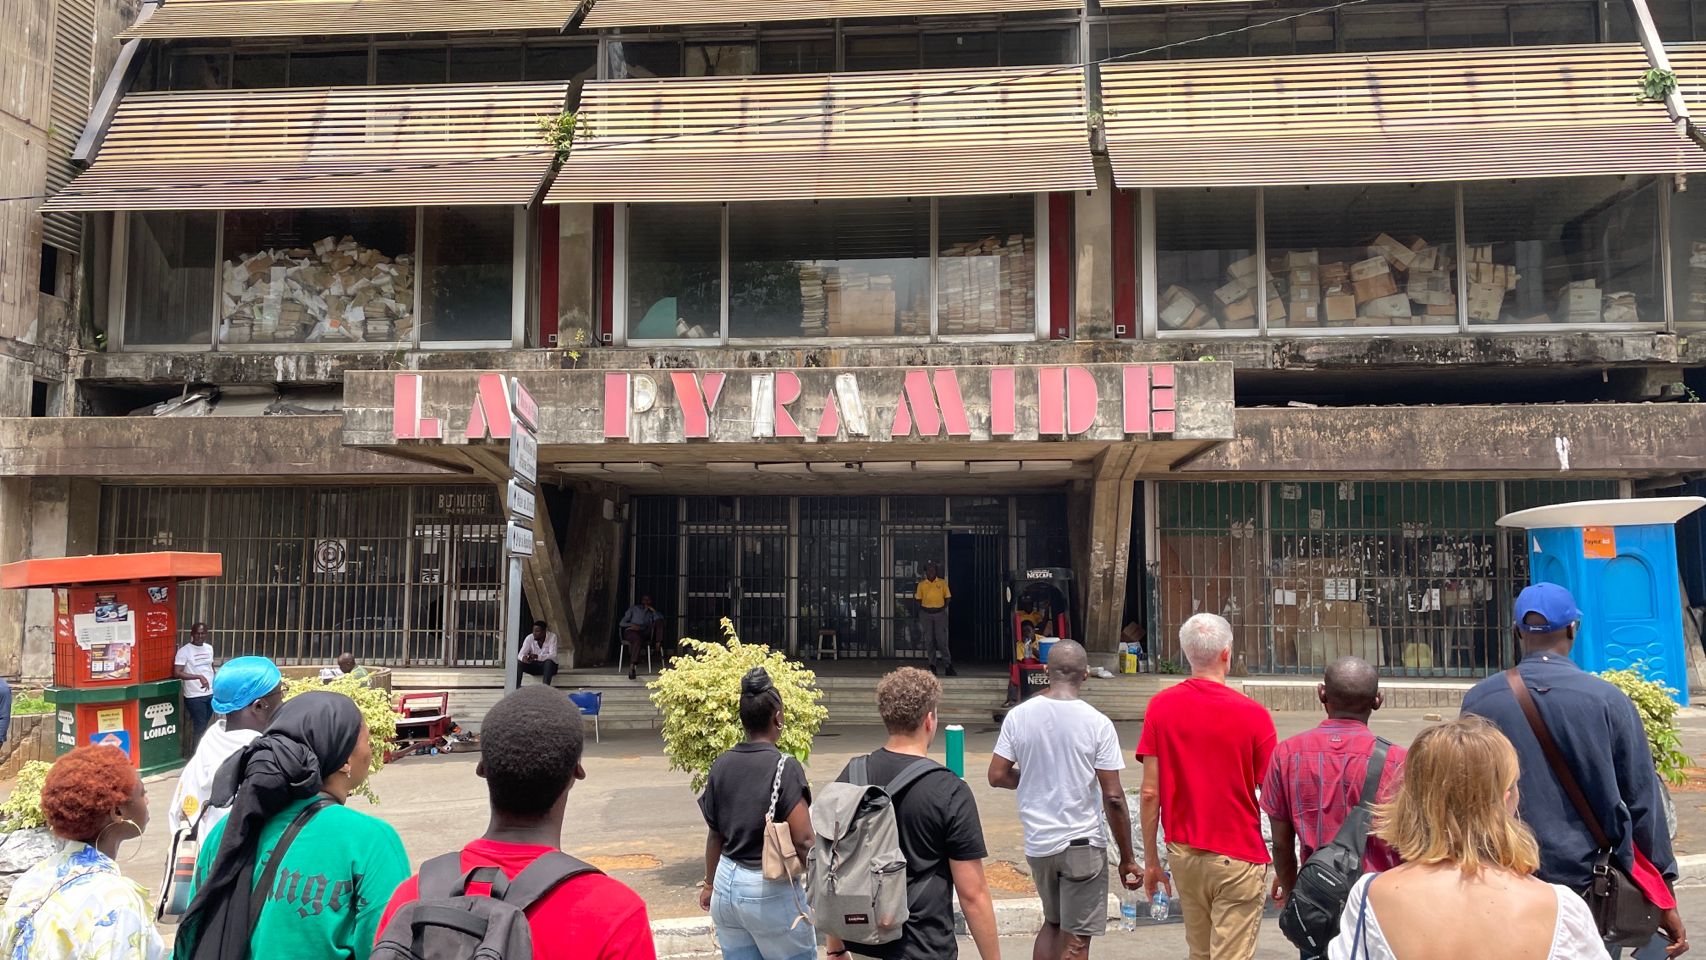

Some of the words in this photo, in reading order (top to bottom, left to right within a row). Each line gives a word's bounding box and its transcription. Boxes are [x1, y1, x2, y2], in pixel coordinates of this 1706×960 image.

[393, 373, 512, 439] LA
[603, 364, 1176, 438] PYRAMIDE
[143, 724, 177, 741] LONACI
